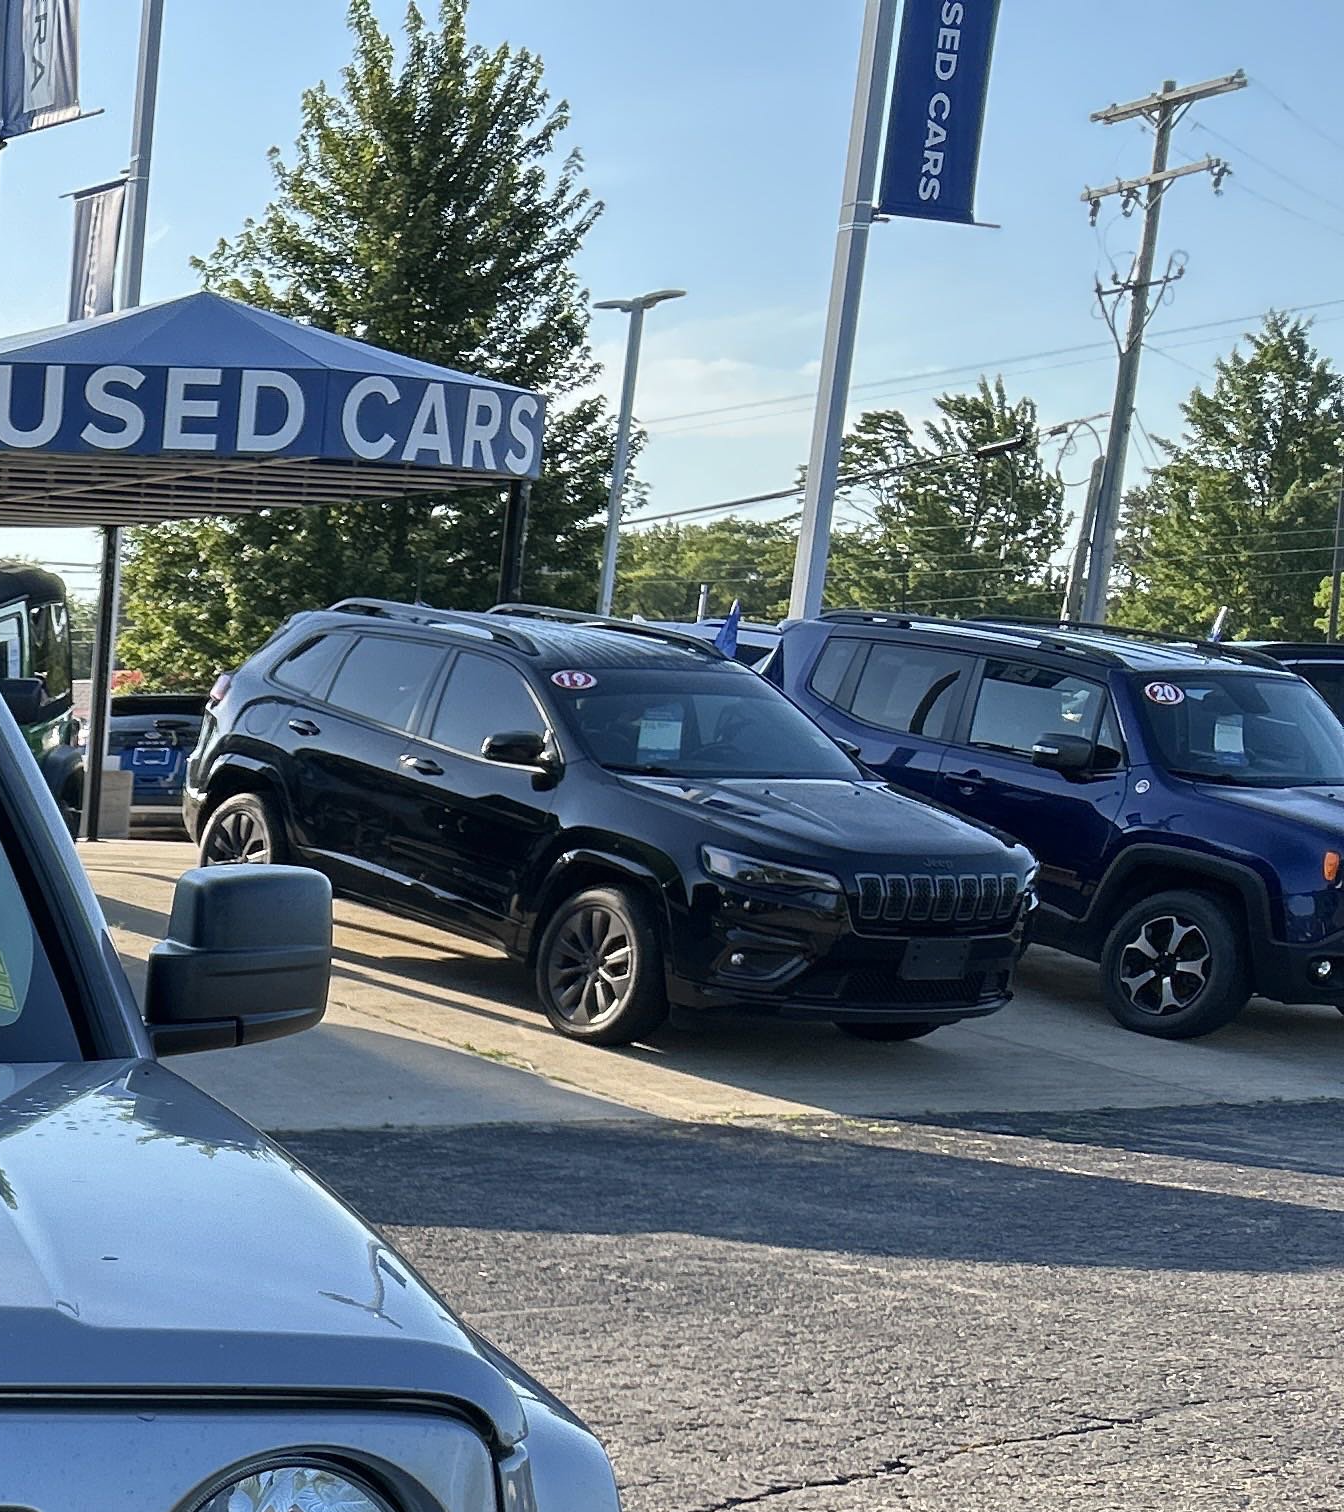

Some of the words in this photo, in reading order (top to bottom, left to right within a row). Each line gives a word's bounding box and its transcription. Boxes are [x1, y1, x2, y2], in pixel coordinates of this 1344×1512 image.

[31, 0, 48, 92] RA
[934, 0, 964, 81] SED
[918, 92, 951, 201] CARS
[341, 375, 539, 476] CARS
[561, 672, 587, 687] 19
[1153, 684, 1177, 701] 20
[923, 857, 954, 870] Jeep
